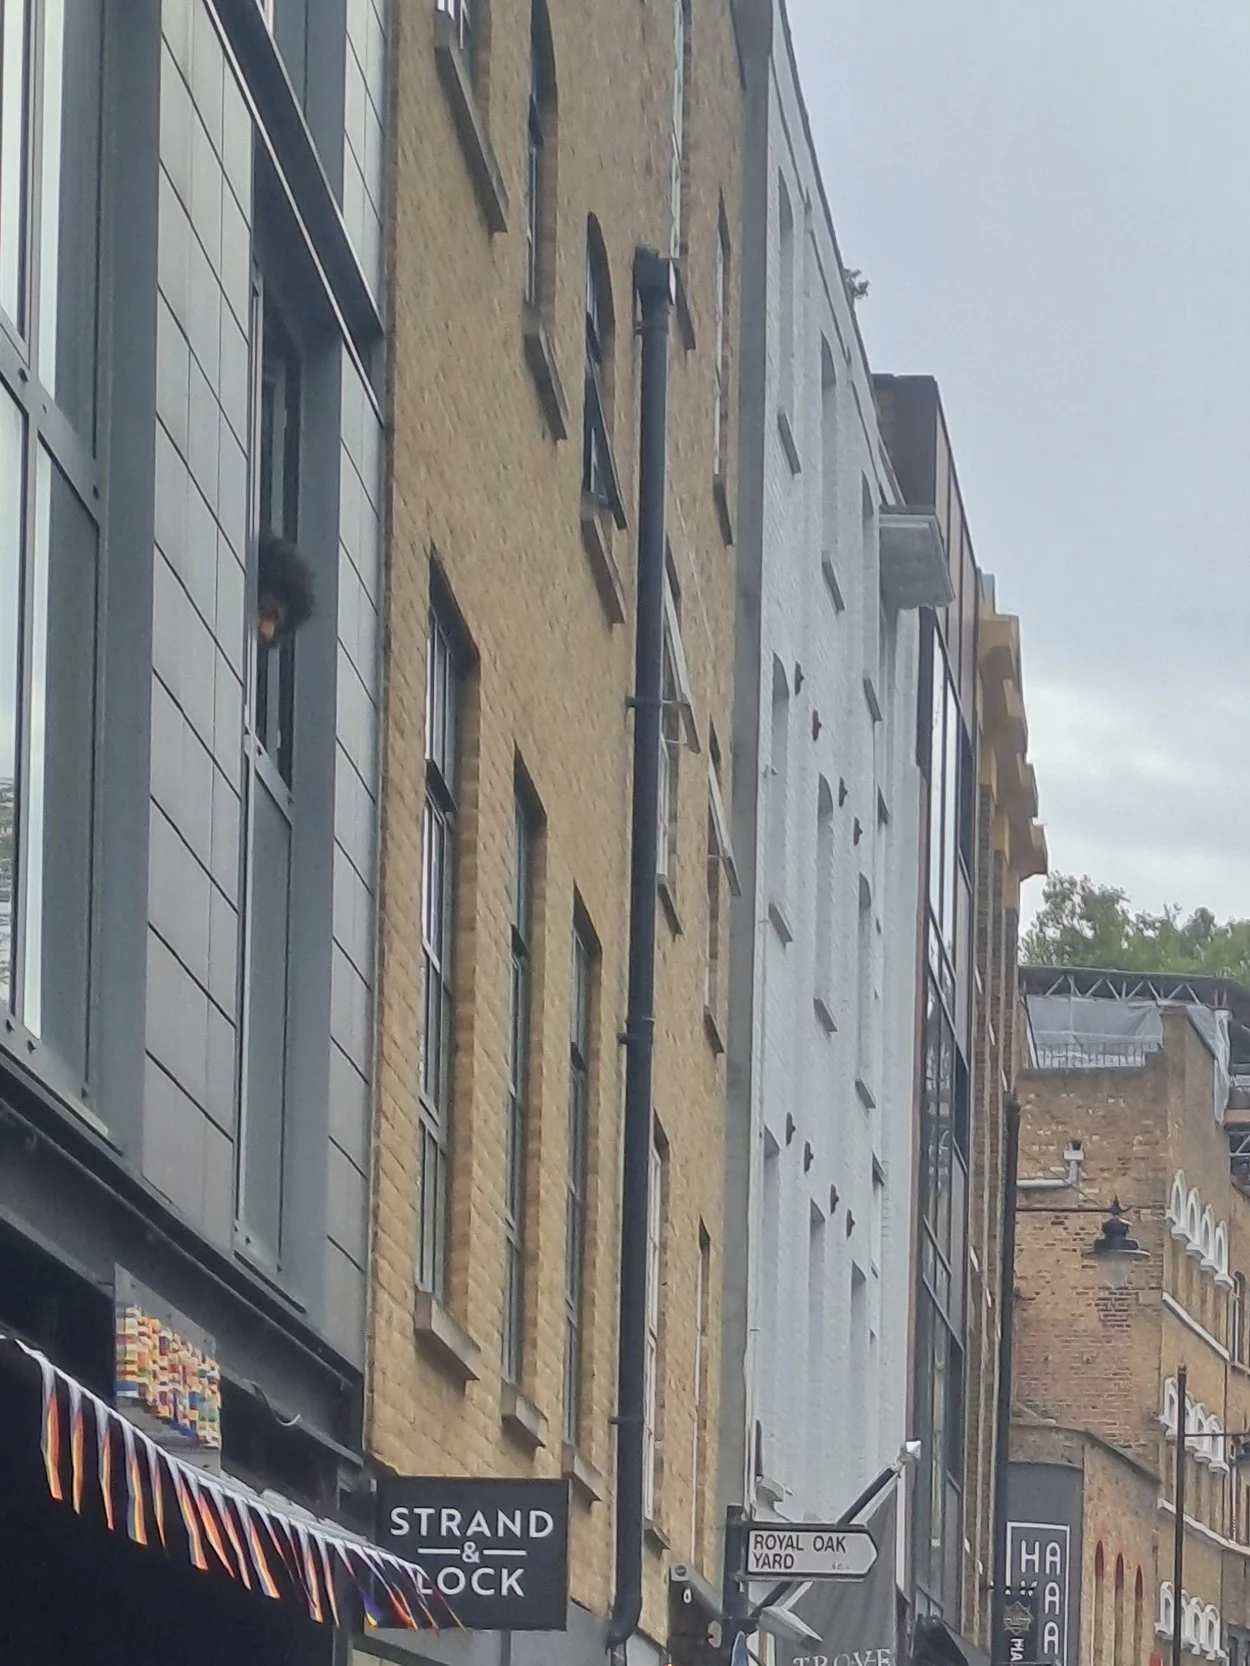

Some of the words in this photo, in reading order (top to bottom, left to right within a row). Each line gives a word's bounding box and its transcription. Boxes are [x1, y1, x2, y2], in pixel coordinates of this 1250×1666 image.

[390, 1507, 554, 1538] STRAND
[461, 1541, 480, 1563] &
[753, 1533, 804, 1551] ROYAL
[812, 1535, 847, 1553] OAK
[753, 1552, 795, 1569] YARD
[417, 1566, 525, 1597] LOCK
